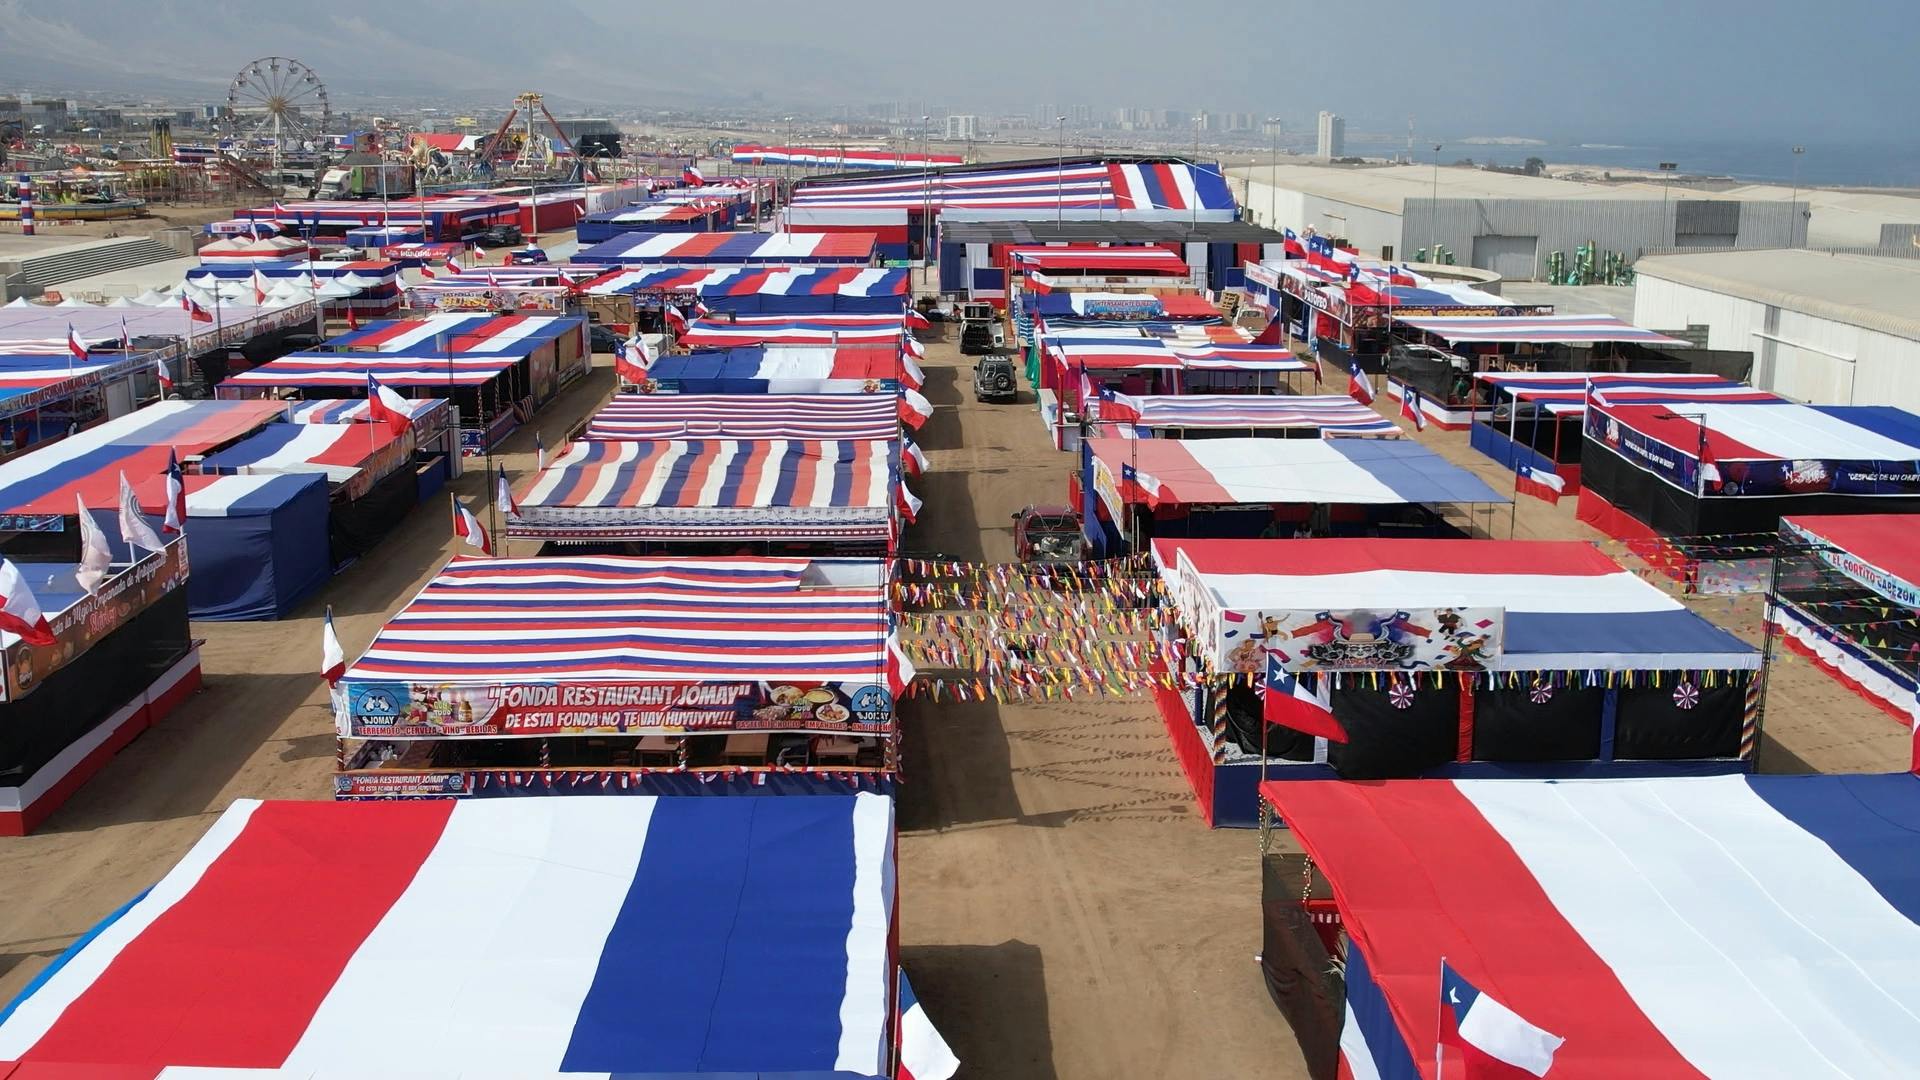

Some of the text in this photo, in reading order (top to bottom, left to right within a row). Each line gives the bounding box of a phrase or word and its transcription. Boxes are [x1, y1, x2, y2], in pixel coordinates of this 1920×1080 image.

[1832, 554, 1841, 567] EL
[1843, 559, 1876, 584] CORTITO
[562, 685, 676, 707] RESTAURANT
[675, 684, 750, 706] JOMAY"
[368, 716, 395, 725] JOMAY
[505, 712, 522, 728] DE
[524, 711, 553, 727] ESTA
[556, 711, 599, 728] FONDA
[600, 711, 620, 727] NO
[623, 711, 638, 726] TE
[639, 711, 665, 727] VAY
[358, 725, 498, 736] TERREMOTO CERVEZA VINO BEBIDAS
[380, 775, 422, 784] RESTAURANT
